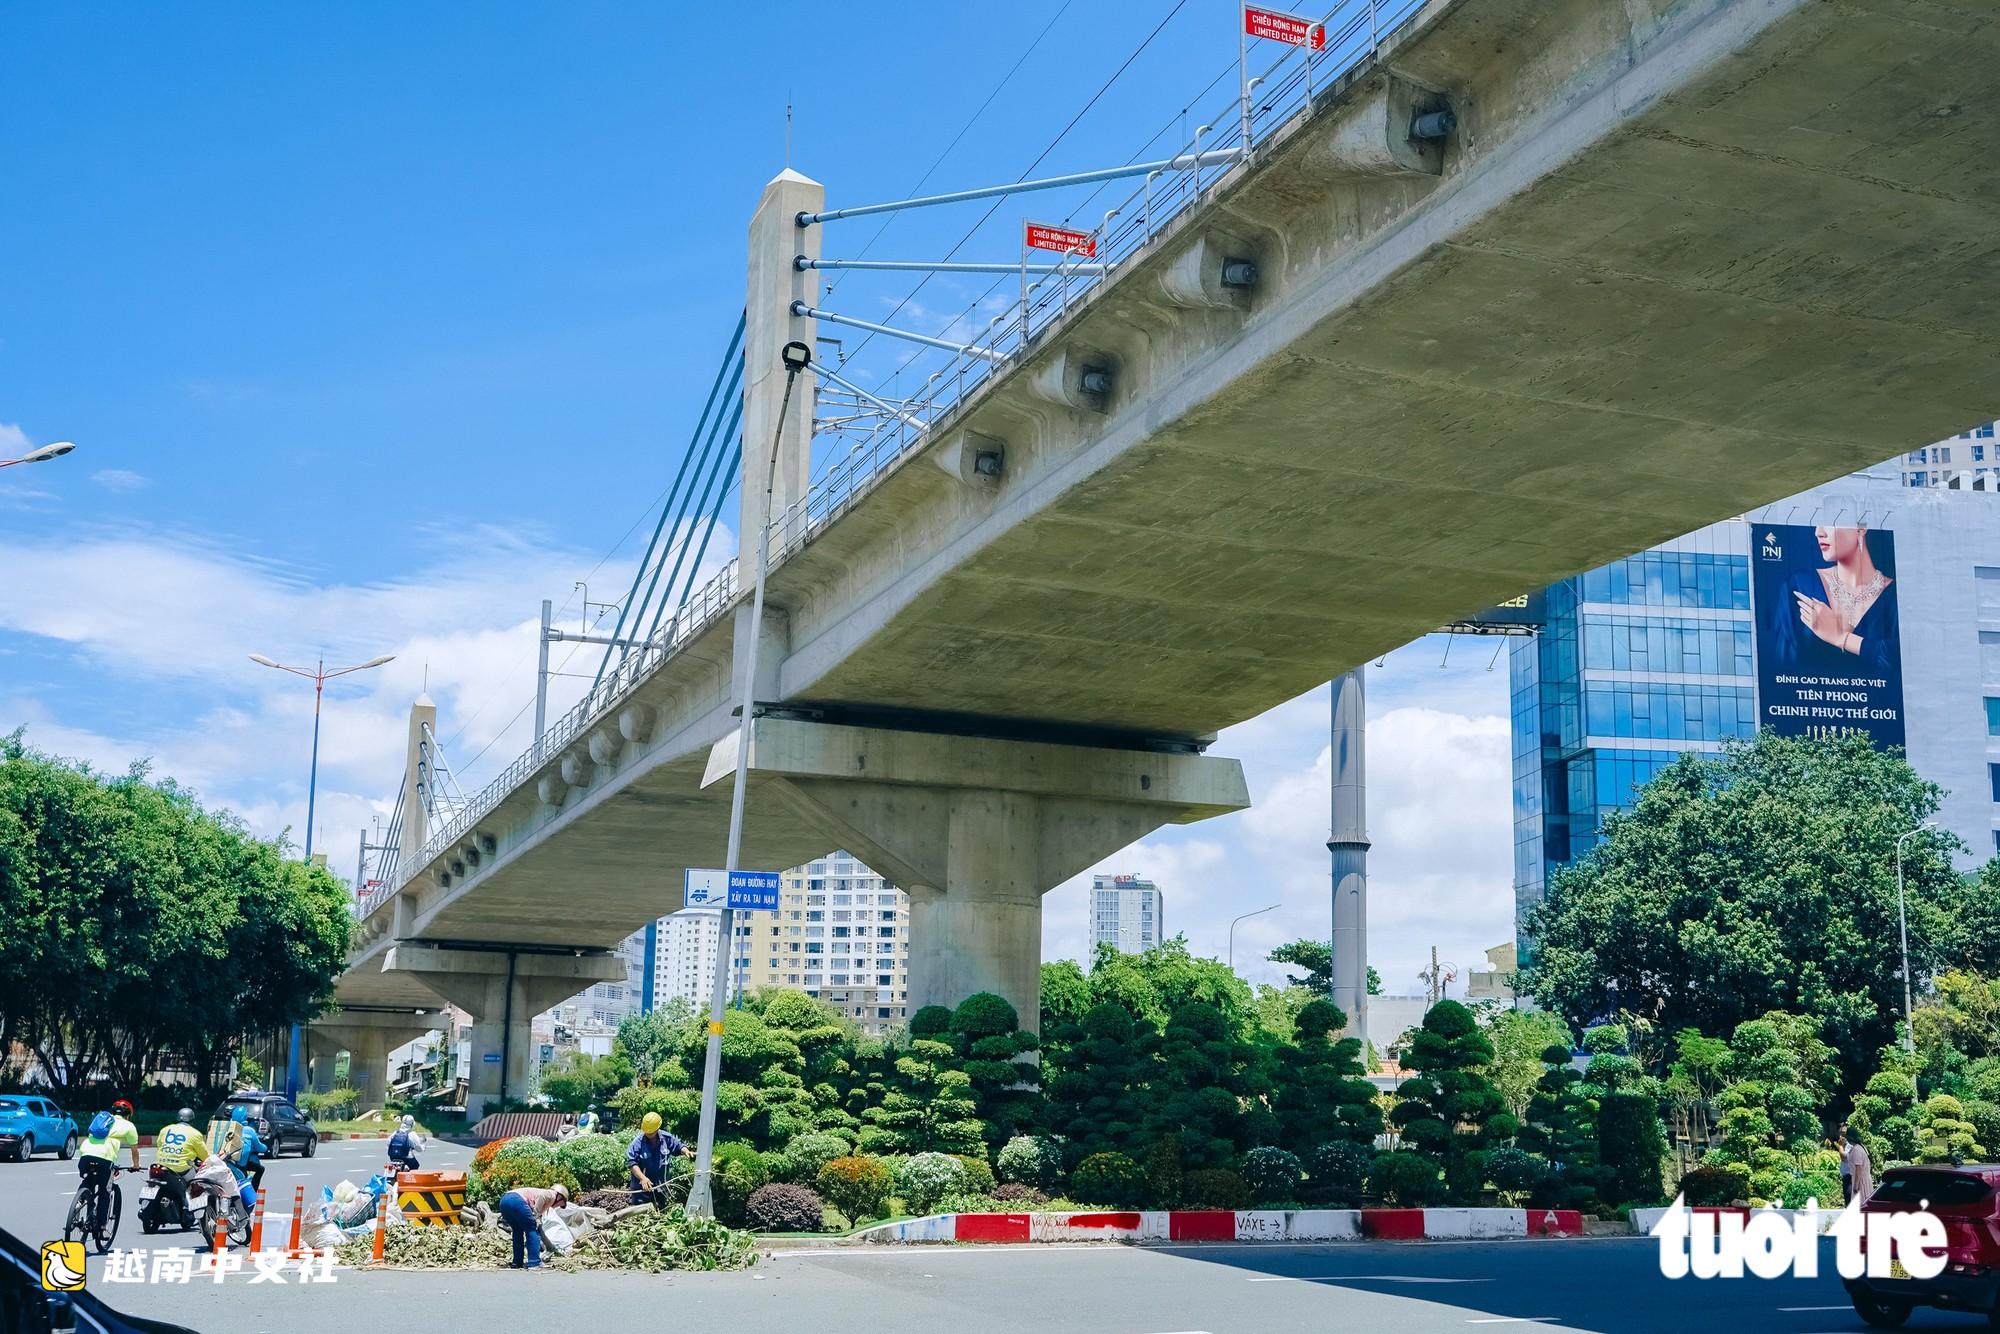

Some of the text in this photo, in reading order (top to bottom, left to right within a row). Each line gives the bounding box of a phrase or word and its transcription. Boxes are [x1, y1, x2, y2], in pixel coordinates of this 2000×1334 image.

[1254, 26, 1280, 39] LIMITED
[1034, 239, 1056, 249] LIMITED
[1762, 545, 1782, 559] PNJ
[1801, 676, 1818, 684] CAO
[1820, 677, 1849, 686] TRANG
[1867, 678, 1886, 688] VIỆT
[1796, 689, 1868, 702] TIÊN PHONG
[1769, 705, 1896, 720] CHINH PHỤC THẾ GIỚI
[731, 877, 746, 888] ĐOẠN
[766, 879, 778, 888] HAY
[743, 894, 751, 903] RA
[165, 1129, 186, 1145] be
